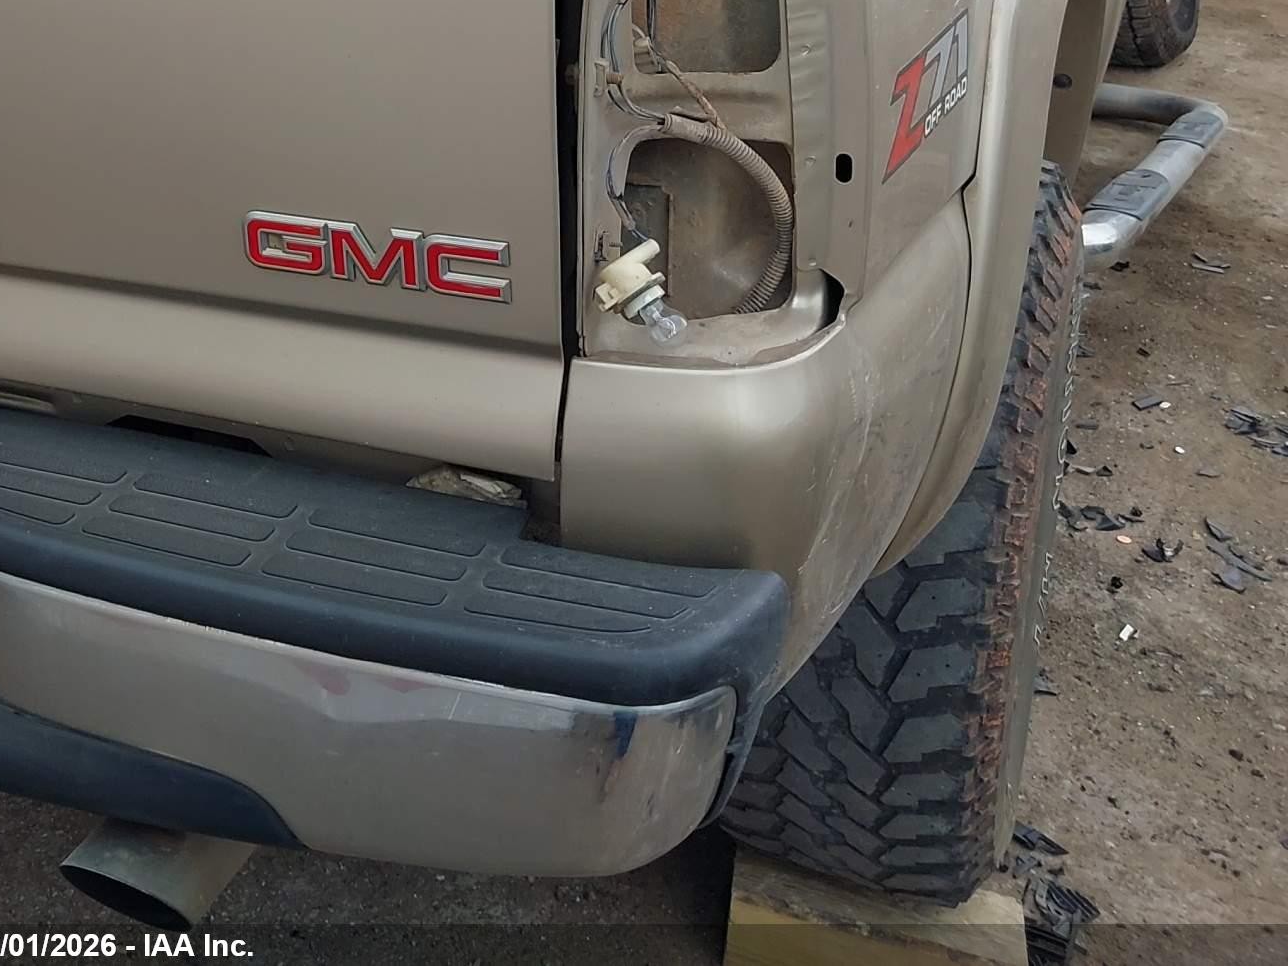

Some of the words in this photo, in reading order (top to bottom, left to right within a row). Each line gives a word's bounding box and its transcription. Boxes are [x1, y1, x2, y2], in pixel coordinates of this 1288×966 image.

[882, 9, 969, 184] Z71
[923, 102, 943, 137] OFF
[943, 75, 968, 115] ROAD
[243, 209, 512, 304] GMC
